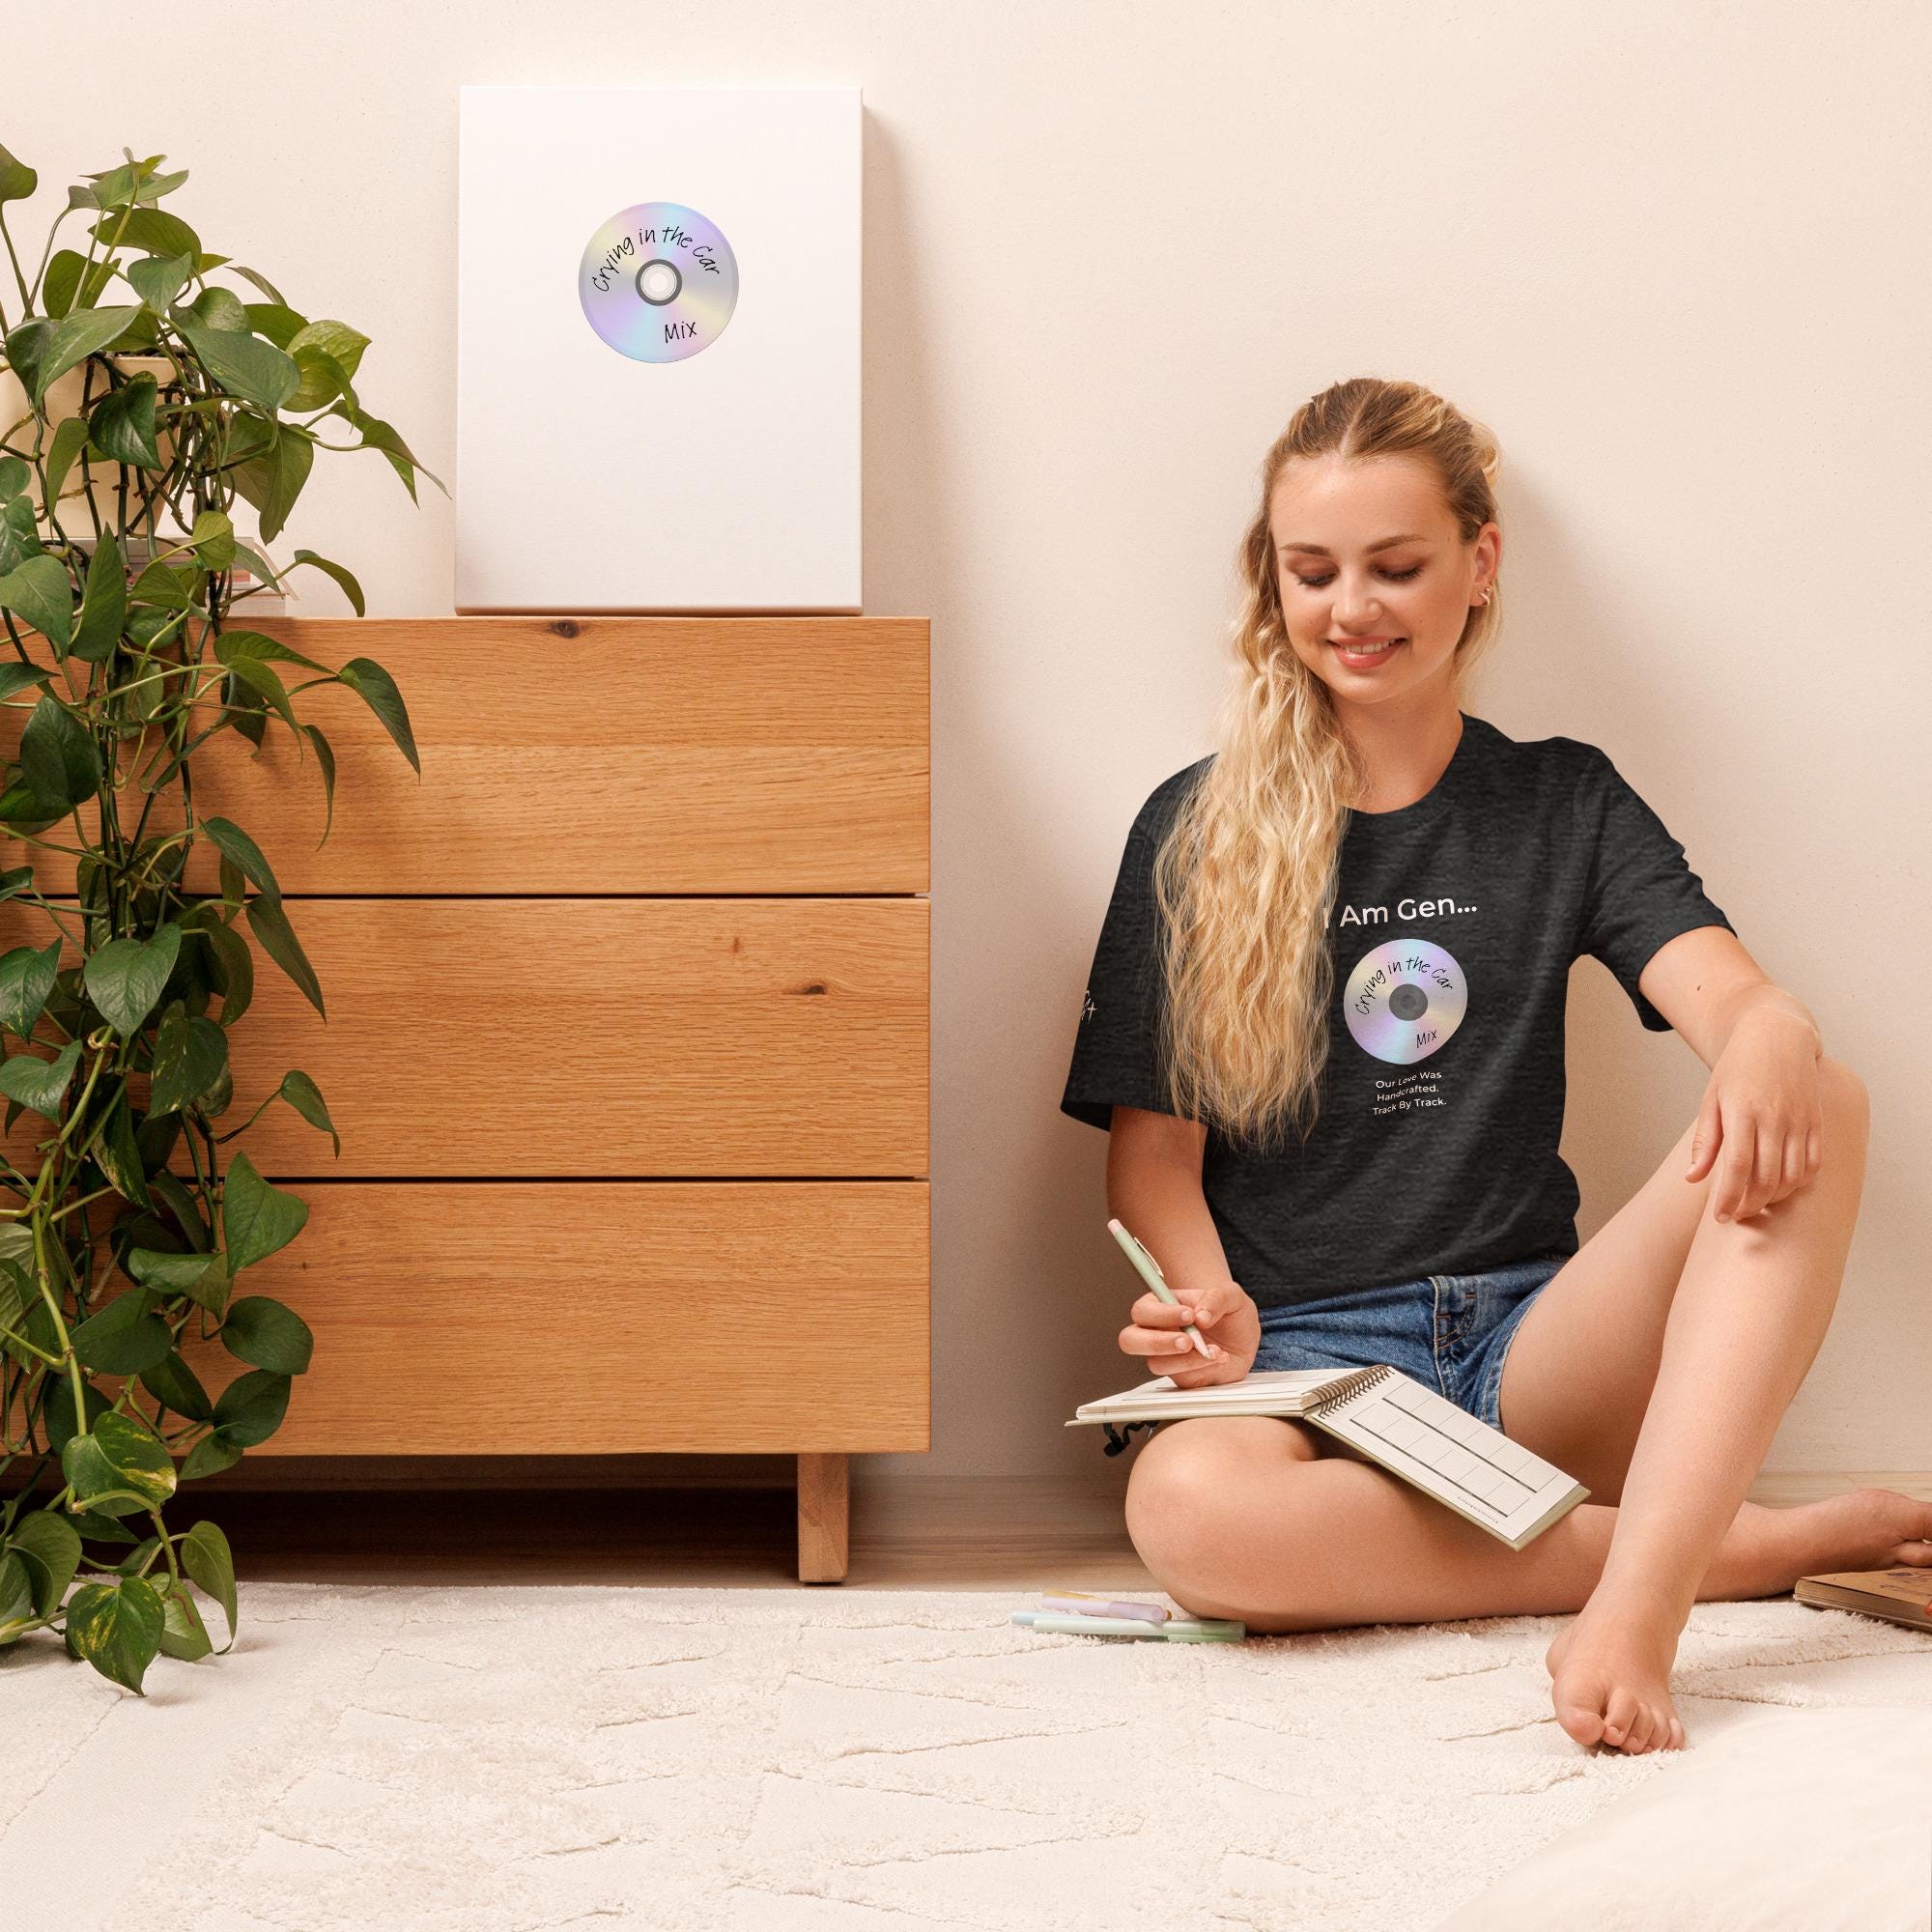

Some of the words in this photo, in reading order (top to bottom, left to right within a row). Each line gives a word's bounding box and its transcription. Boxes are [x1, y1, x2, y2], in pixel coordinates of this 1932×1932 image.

[592, 237, 635, 292] Crying
[639, 228, 656, 245] in
[662, 226, 693, 248] the
[693, 245, 720, 274] Car
[665, 321, 697, 343] Mix
[1339, 904, 1388, 927] Am
[1397, 897, 1478, 921] Gen...
[1354, 969, 1385, 1014] Crying
[1388, 961, 1402, 974] in
[1406, 955, 1431, 973] the
[1432, 968, 1453, 989] Car
[1416, 1029, 1437, 1048] Mix
[1398, 1074, 1417, 1086] Love
[1373, 1103, 1397, 1115] Track
[1399, 1100, 1411, 1109] By
[1413, 1096, 1447, 1107] Track.
